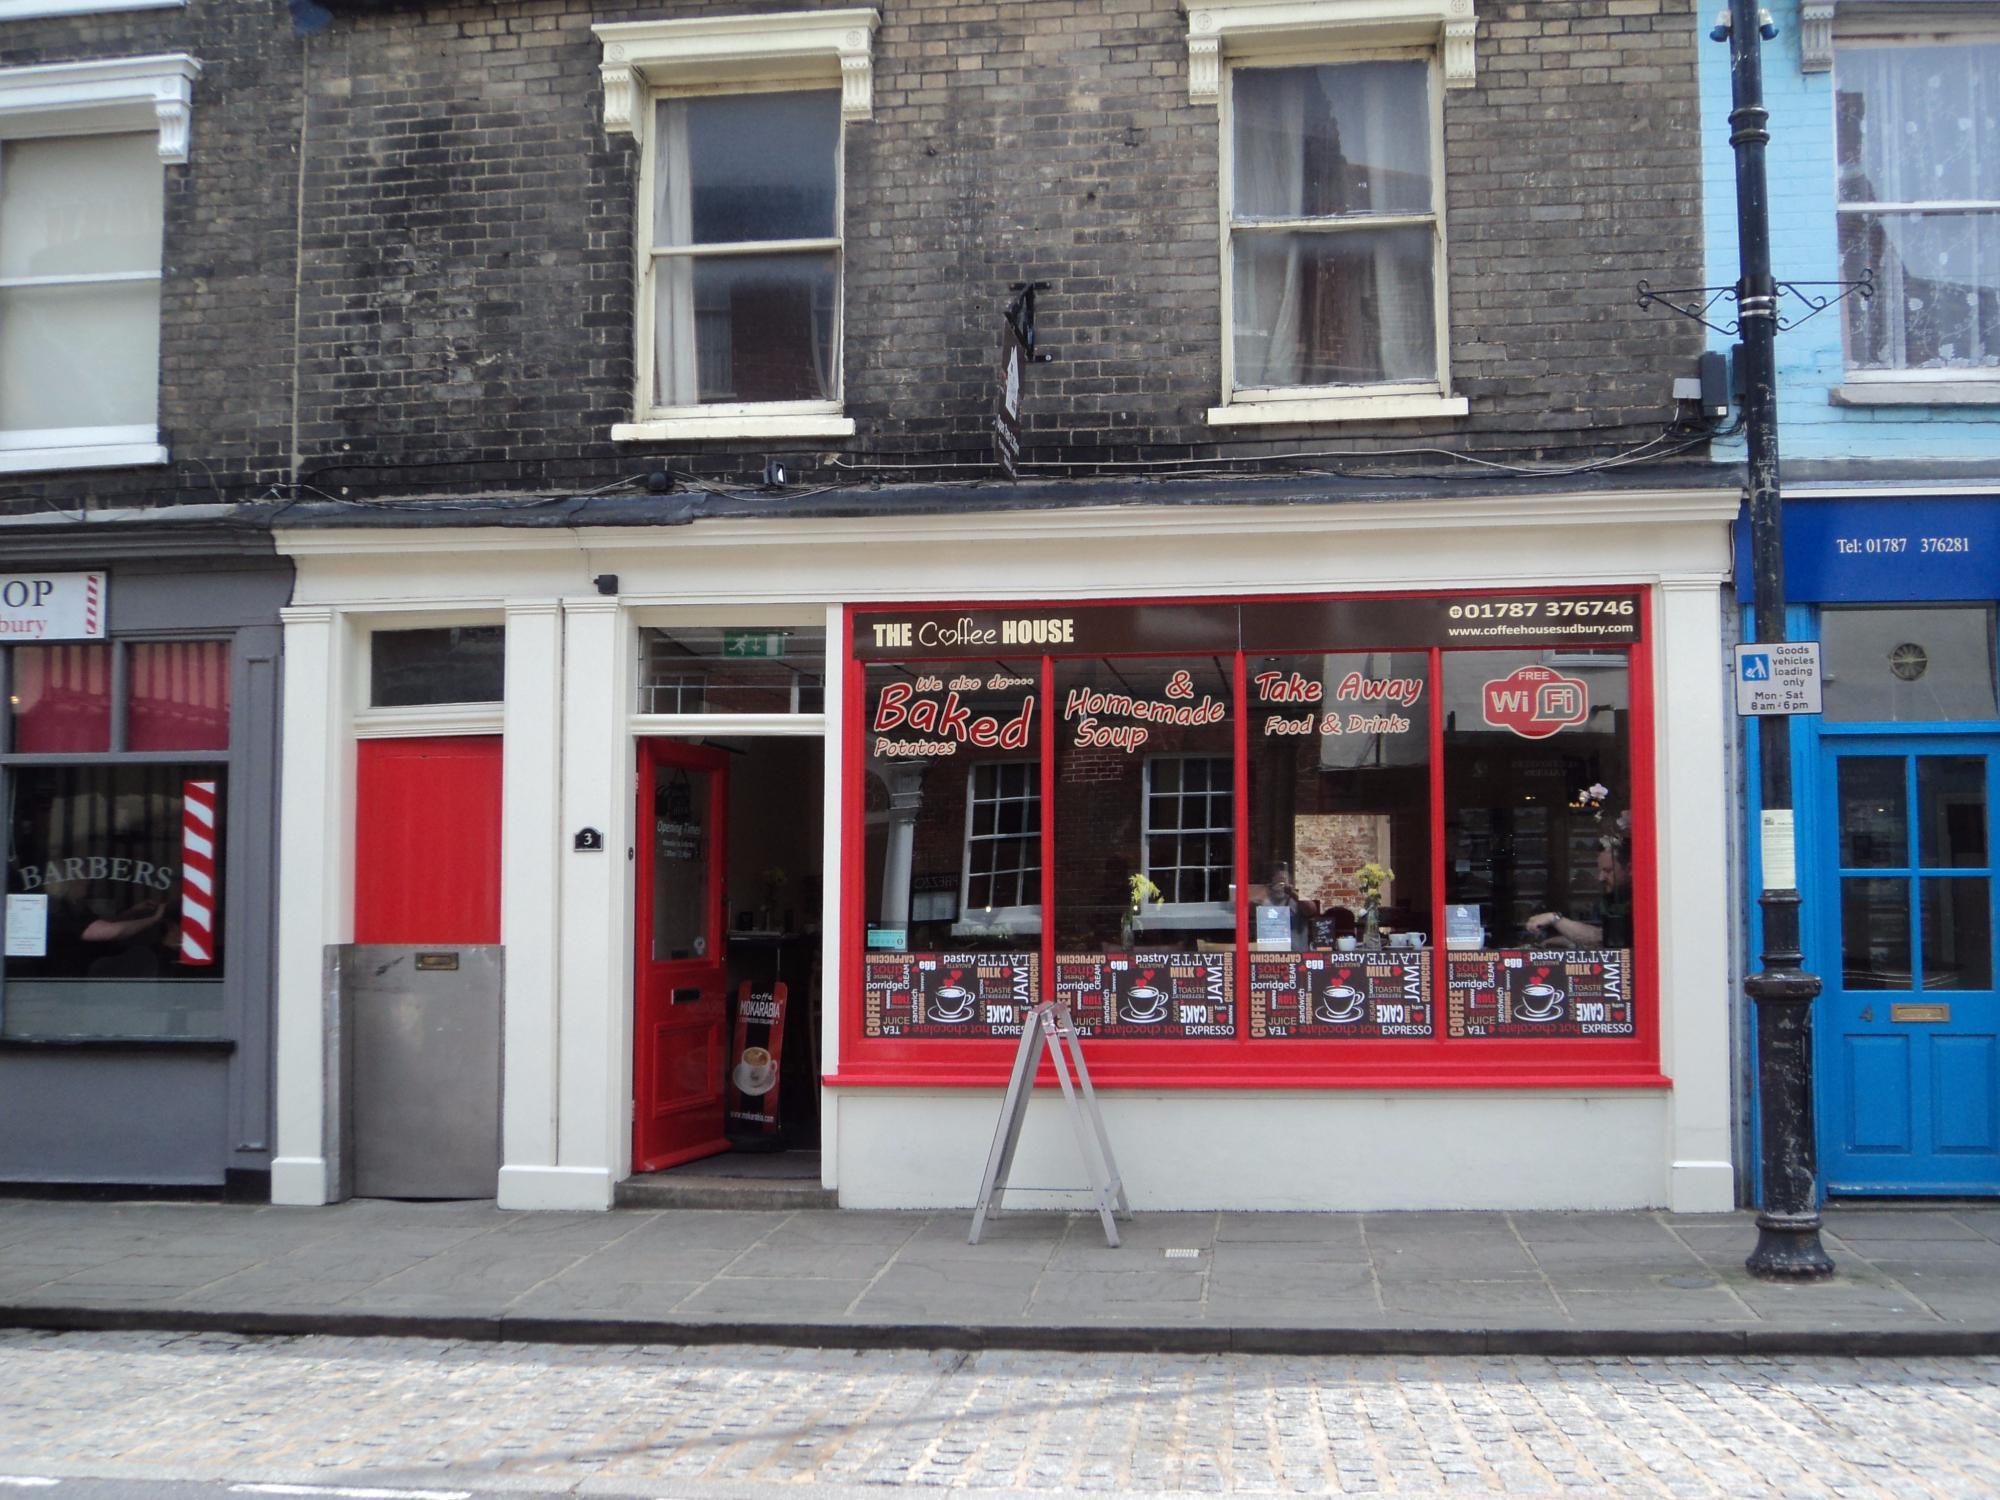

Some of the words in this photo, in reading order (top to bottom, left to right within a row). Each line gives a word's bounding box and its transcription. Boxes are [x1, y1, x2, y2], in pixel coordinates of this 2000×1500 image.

[1837, 539, 1862, 553] Tel:
[1866, 538, 1907, 553] 01787
[1921, 538, 1969, 552] 376281
[1465, 603, 1537, 618] 01787
[1546, 601, 1634, 617] 376746
[873, 623, 912, 647] THE
[919, 618, 997, 647] Coffee
[1002, 619, 1074, 644] HOUSE
[1449, 624, 1633, 636] www.coffeehousesudbury.com
[1776, 646, 1810, 655] Goods
[1772, 657, 1814, 665] vehicles
[1518, 671, 1550, 681] FREE
[1774, 667, 1813, 677] loading
[916, 675, 943, 692] We
[949, 677, 981, 691] also
[1165, 670, 1195, 699] &
[1783, 678, 1805, 688] only
[1255, 671, 1322, 702] Take
[1337, 672, 1423, 707] Away
[1754, 692, 1777, 700] Mon
[1786, 691, 1804, 699] Sat
[1064, 687, 1225, 726] Homemade
[1751, 702, 1757, 710] 8
[1783, 701, 1790, 709] 6
[1792, 701, 1809, 710] pm
[874, 682, 1035, 750] Baked
[1265, 715, 1313, 736] Food
[1320, 712, 1342, 736] &
[1347, 714, 1409, 735] Drinks
[1074, 717, 1149, 754] Soup
[874, 738, 957, 757] Potatoes
[583, 832, 593, 845] 3
[17, 856, 174, 890] BARBERS
[866, 955, 914, 964] CAPPUCCINO
[944, 954, 976, 964] pastry
[978, 955, 1029, 966] LATTE
[1056, 955, 1106, 964] CAPPUCCINO
[1136, 953, 1169, 964] pastry
[1171, 954, 1224, 966] LATTE
[1251, 954, 1301, 962] CAPPUCCINO
[1331, 953, 1365, 963] pastry
[1367, 953, 1420, 964] LATTE
[1448, 952, 1499, 961] CAPPUCCINO
[1530, 951, 1564, 962] pastry
[1566, 950, 1620, 963] LATTE
[919, 961, 936, 970] egg
[1111, 961, 1128, 970] egg
[1306, 960, 1324, 969] egg
[1504, 958, 1522, 968] egg
[873, 965, 902, 974] soup
[977, 968, 1001, 978] MILK
[1064, 965, 1094, 975] soup
[1170, 967, 1195, 978] MILK
[1258, 965, 1289, 975] soup
[1366, 966, 1391, 977] MILK
[1456, 964, 1487, 974] soup
[1565, 964, 1591, 975] MILK
[1621, 949, 1631, 1000] CAPPUCCINO
[1030, 953, 1038, 1003] CAPPUCCINO
[1224, 952, 1233, 1002] CAPPUCCINO
[1421, 951, 1430, 1002] CAPPUCCINO
[1603, 964, 1620, 1000] JAM
[867, 981, 902, 991] porridge
[1013, 967, 1029, 1003] JAM
[1057, 981, 1094, 992] porridge
[1207, 967, 1223, 1003] JAM
[1251, 981, 1289, 991] porridge
[1404, 966, 1420, 1003] JAM
[1449, 980, 1487, 990] porridge
[740, 1000, 780, 1018] MOKARABIA
[867, 991, 880, 1036] COFFEE
[987, 1005, 1012, 1023] CAKE
[1180, 1005, 1206, 1023] CAKE
[1251, 991, 1266, 1037] COFFEE
[1376, 1005, 1403, 1022] CAKE
[1449, 990, 1465, 1036] COFFEE
[1576, 1003, 1603, 1021] CAKE
[884, 1017, 910, 1025] JUICE
[1268, 1017, 1297, 1025] JUICE
[883, 1026, 901, 1035] TEA
[913, 1024, 967, 1035] chocolate
[971, 1024, 989, 1034] hot
[1074, 1027, 1092, 1036] TEA
[1104, 1024, 1160, 1035] chocolate
[1163, 1025, 1183, 1035] hot
[1186, 1026, 1234, 1035] EXPRESSO
[1268, 1027, 1287, 1035] TEA
[1300, 1024, 1357, 1035] chocolate
[1360, 1025, 1380, 1035] hot
[1383, 1025, 1432, 1034] EXPRESSO
[1467, 1026, 1486, 1034] TEA
[1499, 1023, 1556, 1034] chocolate
[1560, 1023, 1579, 1035] hot
[1583, 1024, 1632, 1033] EXPRESSO
